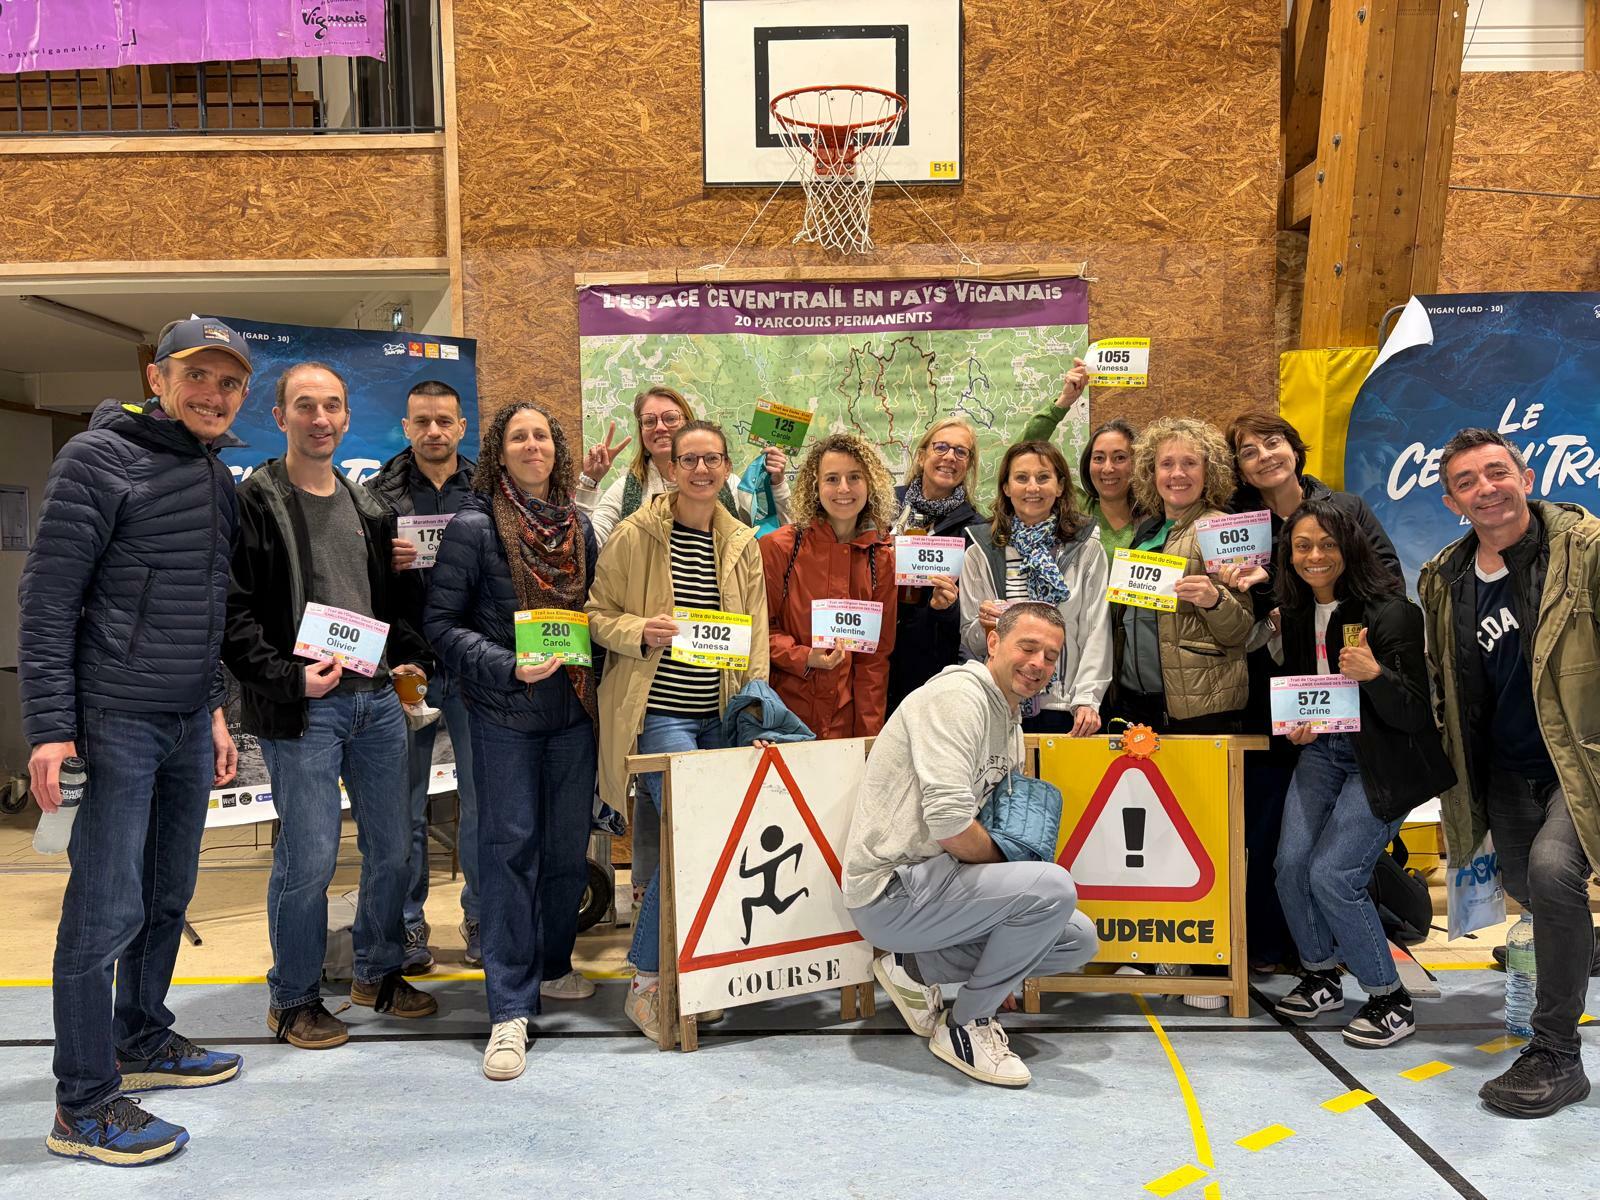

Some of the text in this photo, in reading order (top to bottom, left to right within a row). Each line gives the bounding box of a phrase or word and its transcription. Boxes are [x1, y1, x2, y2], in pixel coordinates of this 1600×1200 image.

[302, 7, 368, 40] Viganais
[933, 163, 955, 173] B11
[602, 289, 700, 310] L'ESPACE
[853, 288, 883, 309] EN
[890, 286, 948, 307] PAYS
[735, 306, 933, 329] 20 PARCOURS PERMANENTS
[1428, 307, 1455, 315] VIGAN
[1457, 305, 1483, 316] (GARD
[1490, 305, 1504, 315] 30)
[242, 331, 270, 341] (GARD
[277, 335, 290, 344] 30)
[1097, 350, 1130, 364] 1055
[1096, 364, 1129, 372] Vanessa
[1497, 397, 1545, 435] LE
[775, 416, 795, 433] 125
[417, 528, 445, 542] 178
[1219, 528, 1250, 545] 603
[917, 549, 944, 563] 853
[1216, 543, 1256, 555] Laurence
[1130, 564, 1162, 582] 1079
[835, 612, 862, 627] 606
[328, 621, 361, 643] 600
[541, 622, 571, 637] 280
[692, 624, 732, 642] 1302
[830, 625, 866, 637] Valentine
[326, 636, 357, 653] Olivier
[542, 638, 571, 647] Carole
[691, 641, 730, 651] Vanessa
[1297, 690, 1331, 706] 572
[1298, 707, 1331, 716] Carine
[727, 958, 841, 998] COURSE
